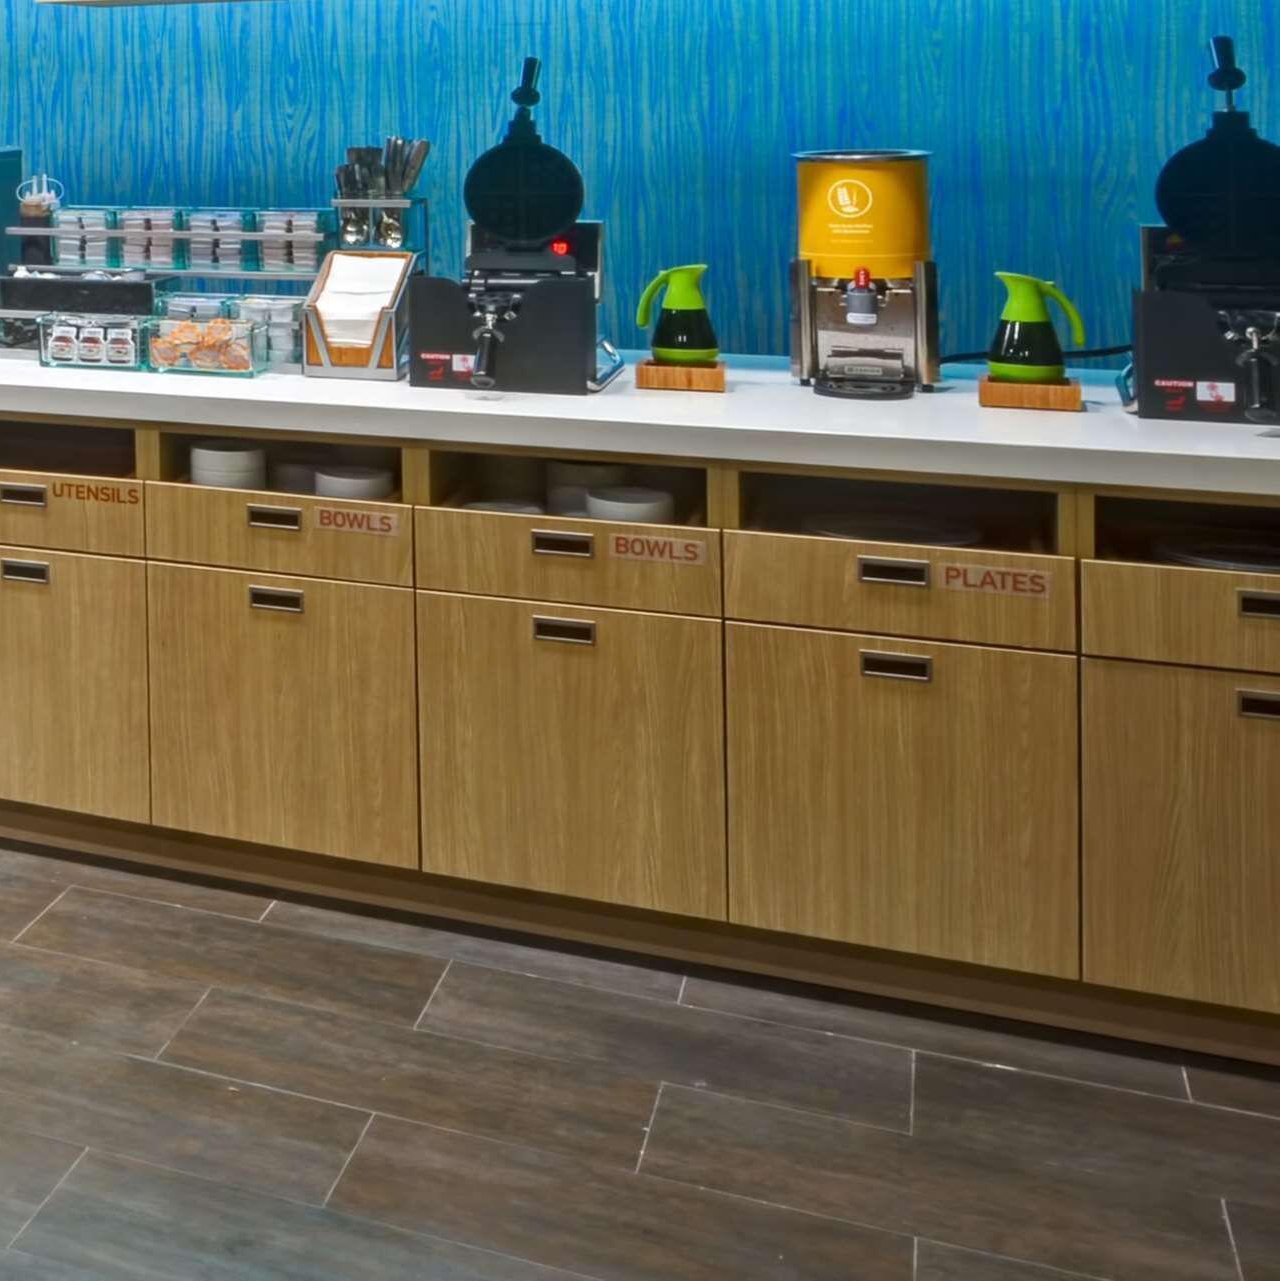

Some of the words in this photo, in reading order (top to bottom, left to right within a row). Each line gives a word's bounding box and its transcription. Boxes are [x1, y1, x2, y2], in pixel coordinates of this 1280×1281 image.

[1154, 379, 1194, 388] CAUTION
[51, 481, 140, 505] UTENSILS
[319, 509, 393, 532] BOWLS
[613, 534, 700, 561] BOWLS
[944, 566, 1047, 595] PLATES
